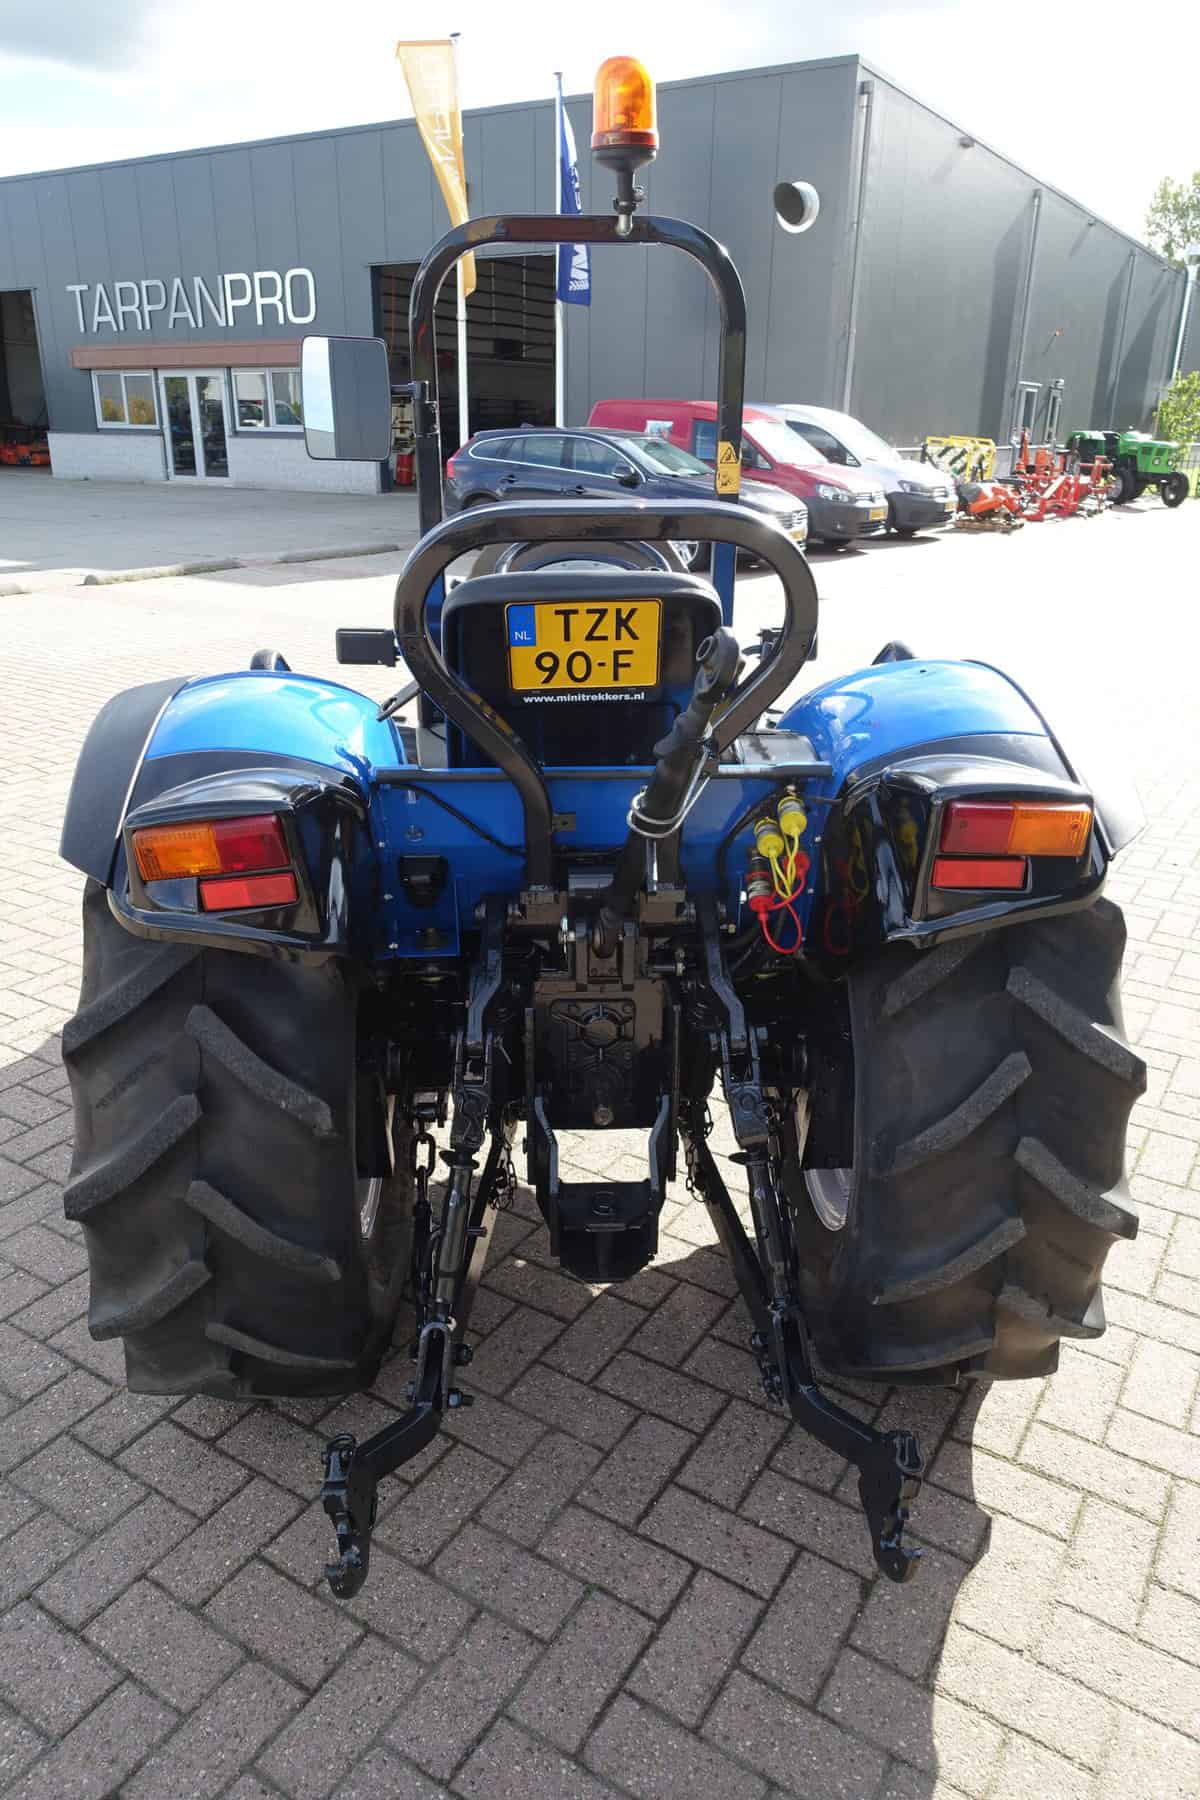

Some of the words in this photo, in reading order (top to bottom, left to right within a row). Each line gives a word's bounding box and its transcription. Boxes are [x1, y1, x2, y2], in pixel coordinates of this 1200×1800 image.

[65, 267, 317, 334] TARPANPRO
[514, 631, 532, 641] NL
[554, 607, 640, 642] TZK
[535, 649, 634, 684] 90-F
[523, 691, 646, 704] www.minitrekkers.nl
